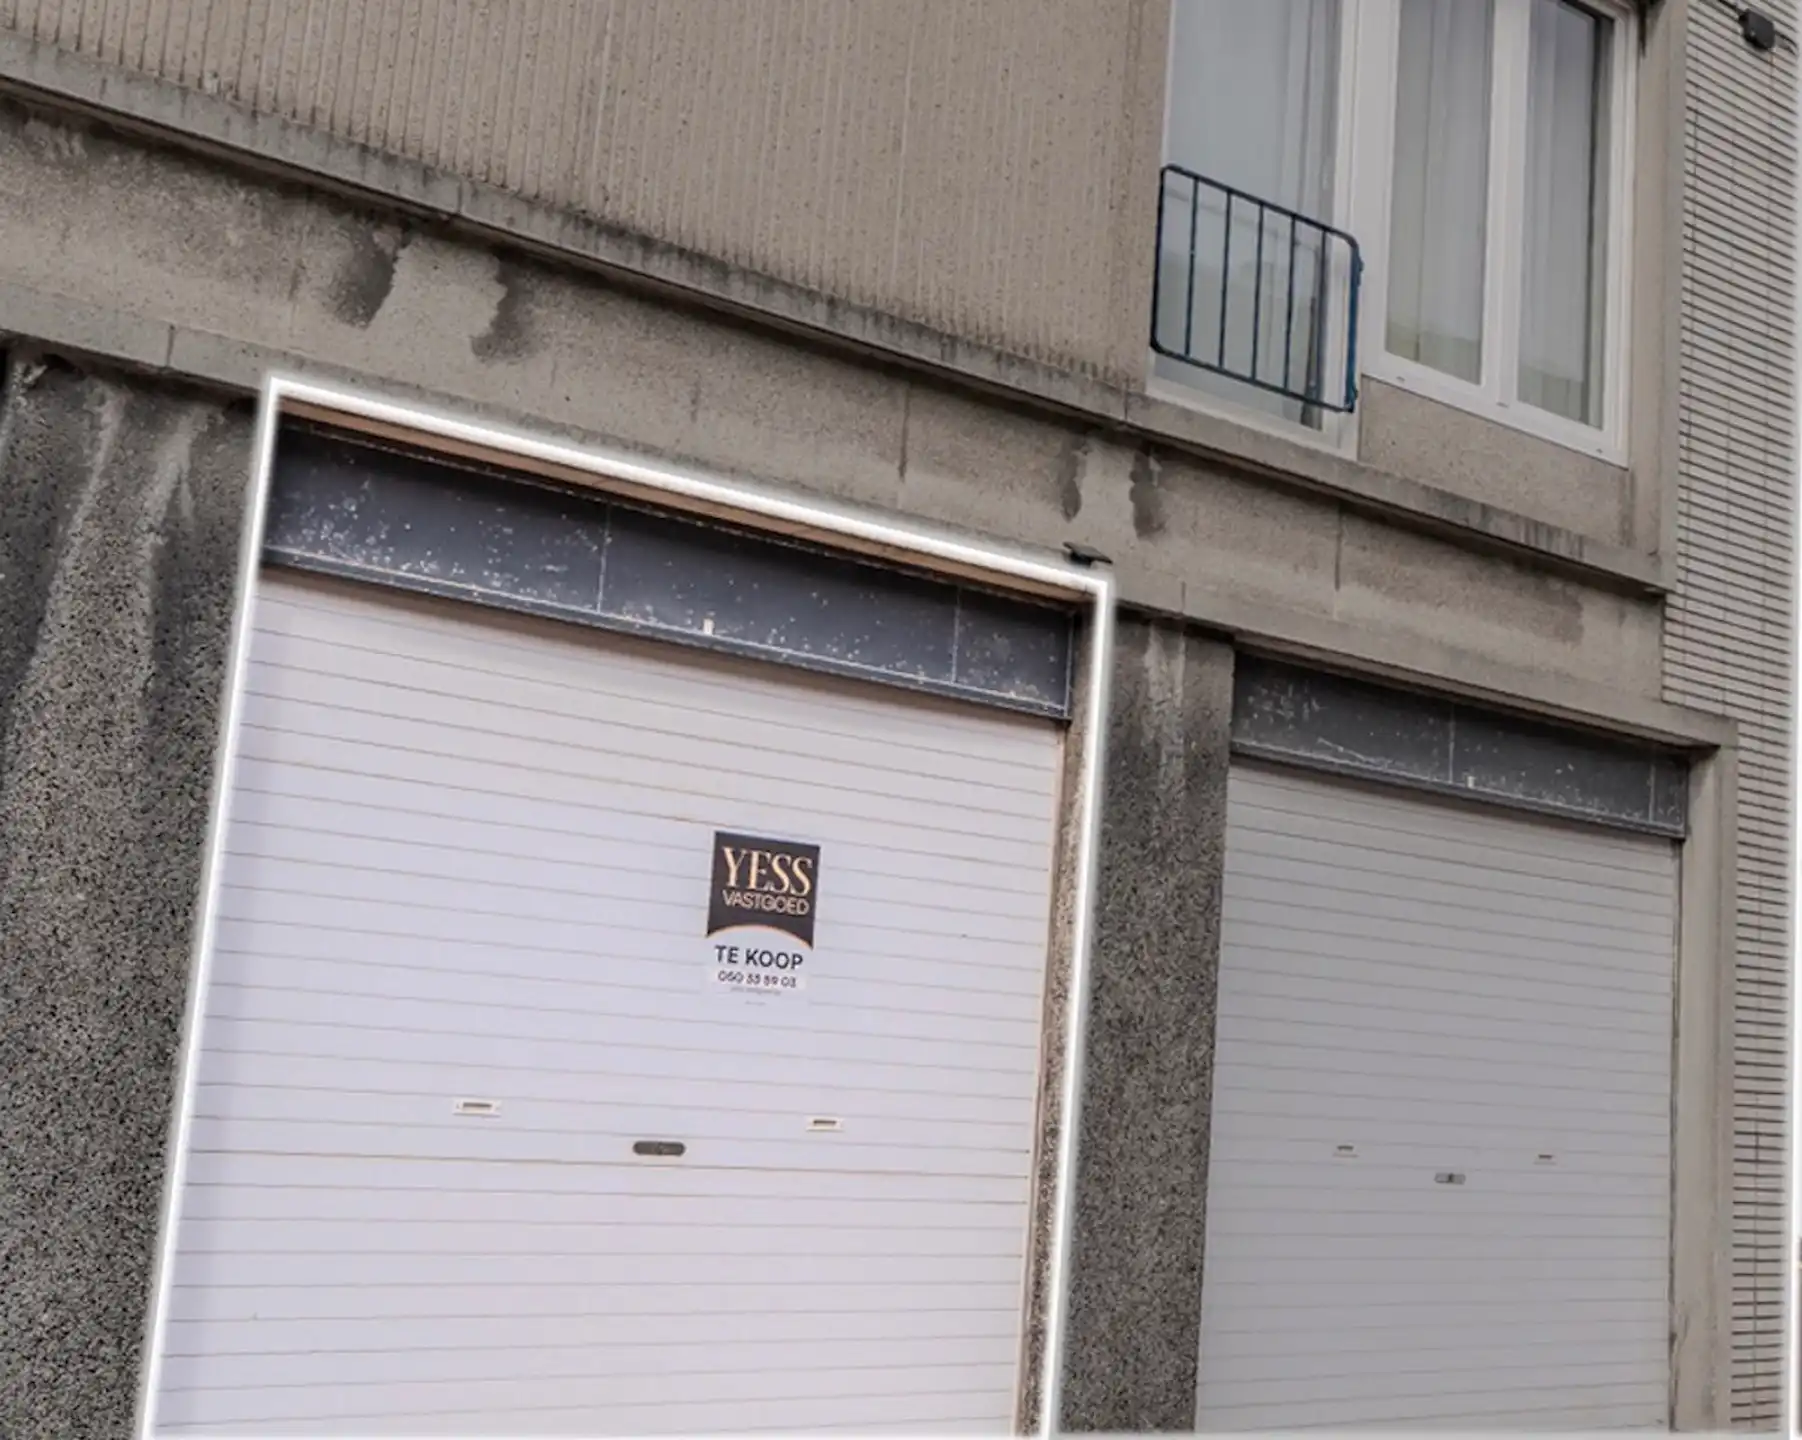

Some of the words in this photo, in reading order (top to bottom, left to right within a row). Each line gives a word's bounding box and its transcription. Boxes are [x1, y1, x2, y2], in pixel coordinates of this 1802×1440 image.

[722, 846, 813, 897] YESS
[722, 889, 810, 915] VASTGOED
[715, 945, 739, 964] TE
[745, 949, 803, 970] KOOP
